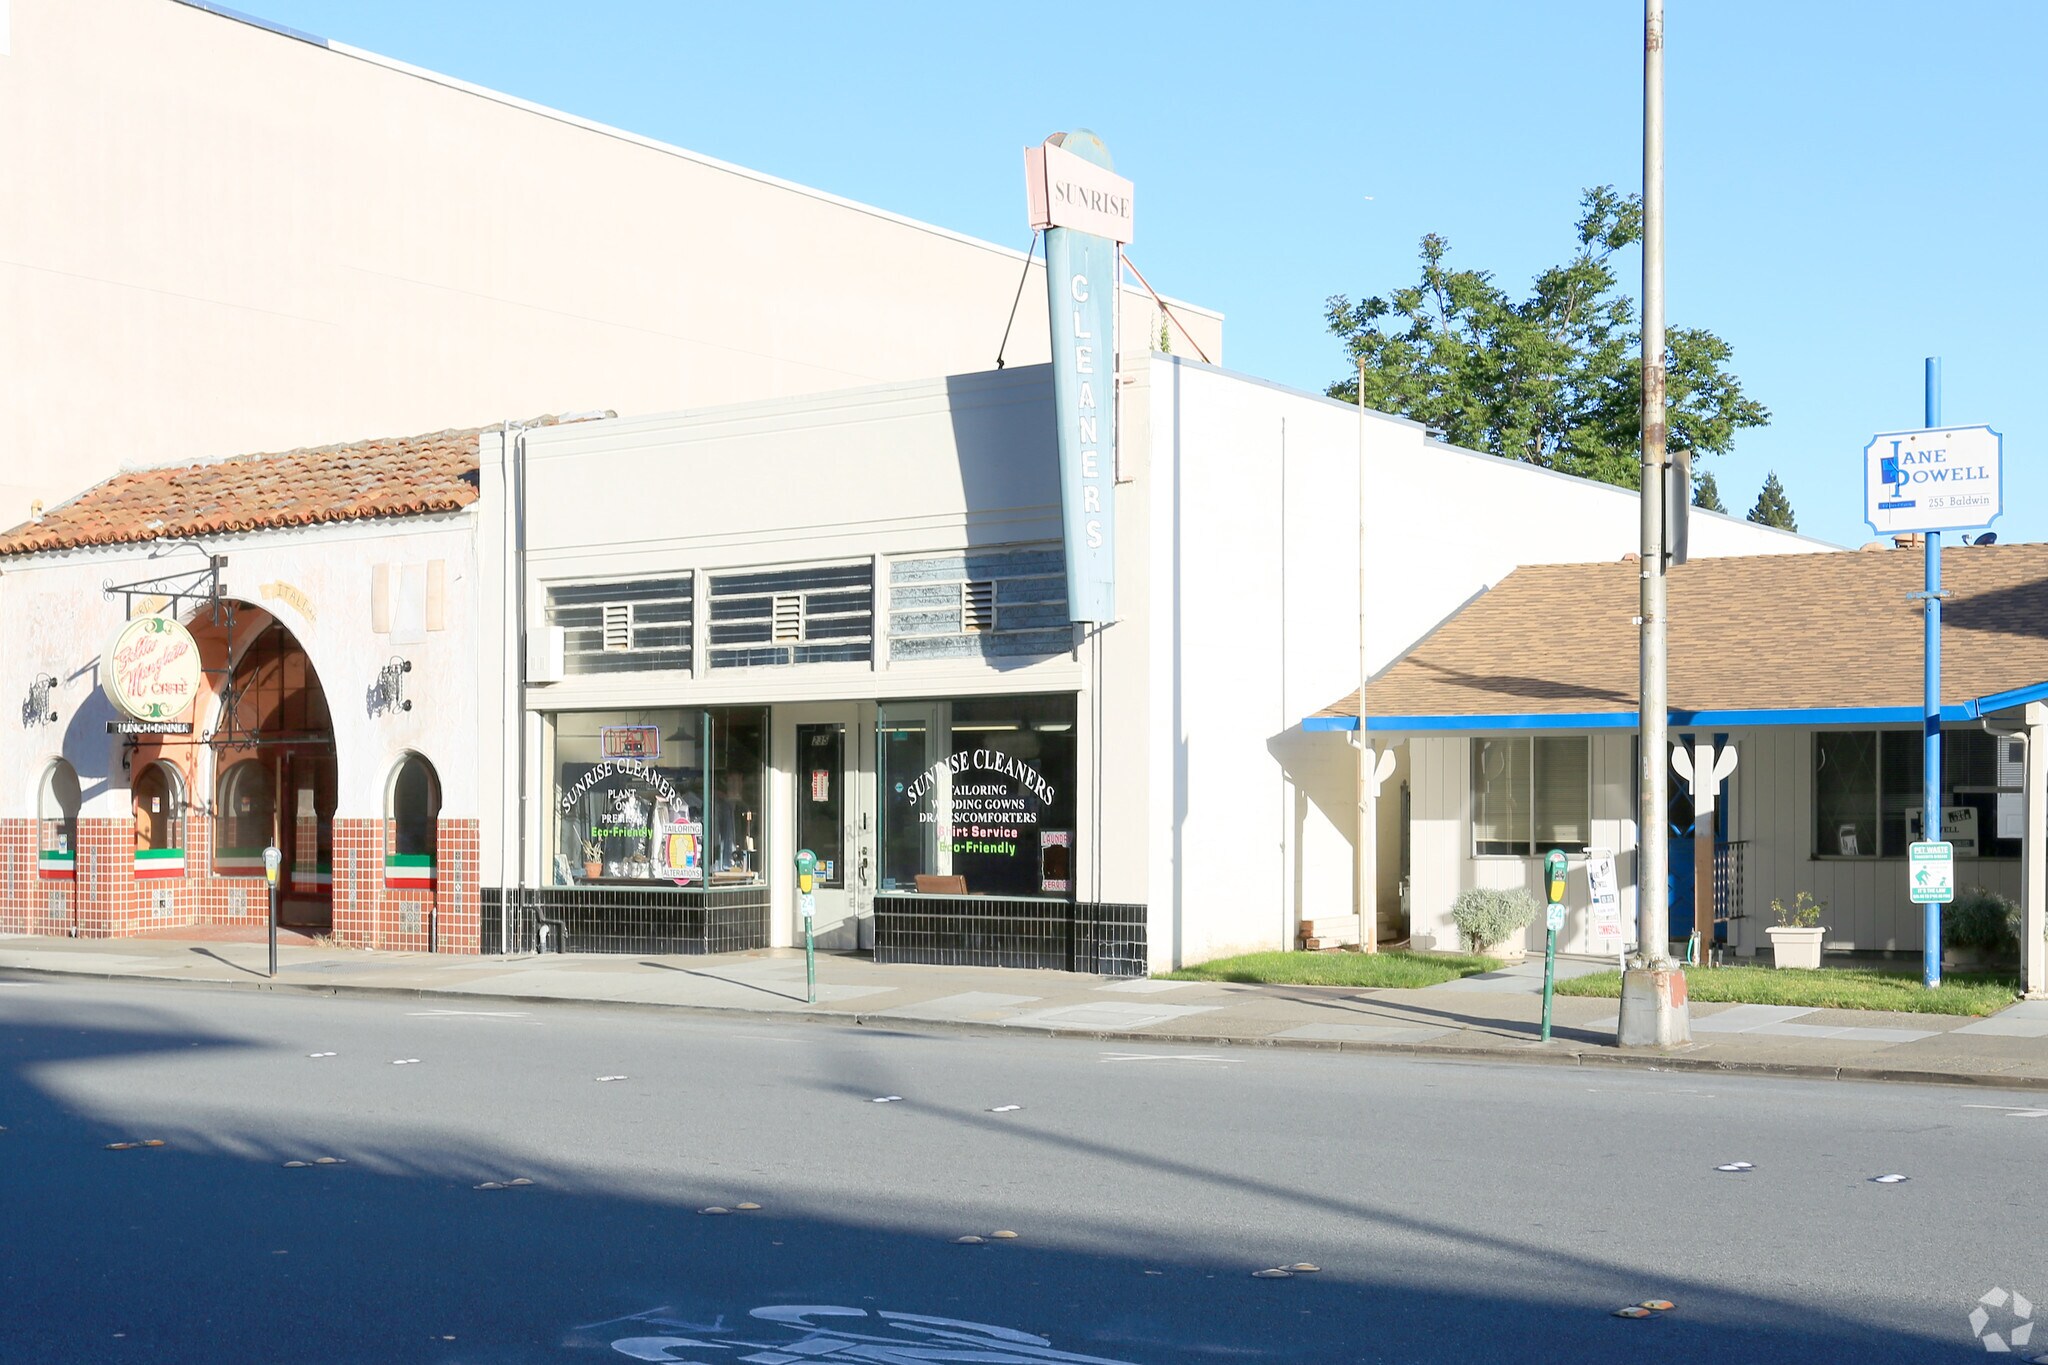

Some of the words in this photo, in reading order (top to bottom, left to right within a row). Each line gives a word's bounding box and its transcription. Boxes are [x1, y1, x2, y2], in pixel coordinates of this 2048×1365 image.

[1056, 181, 1129, 219] SUNRISE
[1071, 273, 1103, 549] CLEANERS
[1892, 466, 1989, 497] POWELL
[1929, 498, 1944, 507] 255
[1950, 495, 1989, 506] Baldwin
[604, 731, 657, 756] OPEN
[973, 749, 1055, 806] CLEANERS
[562, 761, 613, 813] SUNRISE
[617, 758, 683, 813] CLEANERS
[951, 784, 1007, 796] AILORING
[608, 789, 636, 799] PLANT
[932, 799, 982, 810] WDING
[984, 799, 1025, 810] GOWNS
[919, 812, 1037, 823] DRAS/COMFORTERS
[591, 826, 653, 840] Eco-Friendly
[664, 824, 700, 833] TAILORING
[971, 825, 1018, 838] Service
[940, 841, 1016, 857] Eco-Friendly
[664, 868, 700, 877] ALTERATIONS
[1549, 908, 1562, 920] 24
